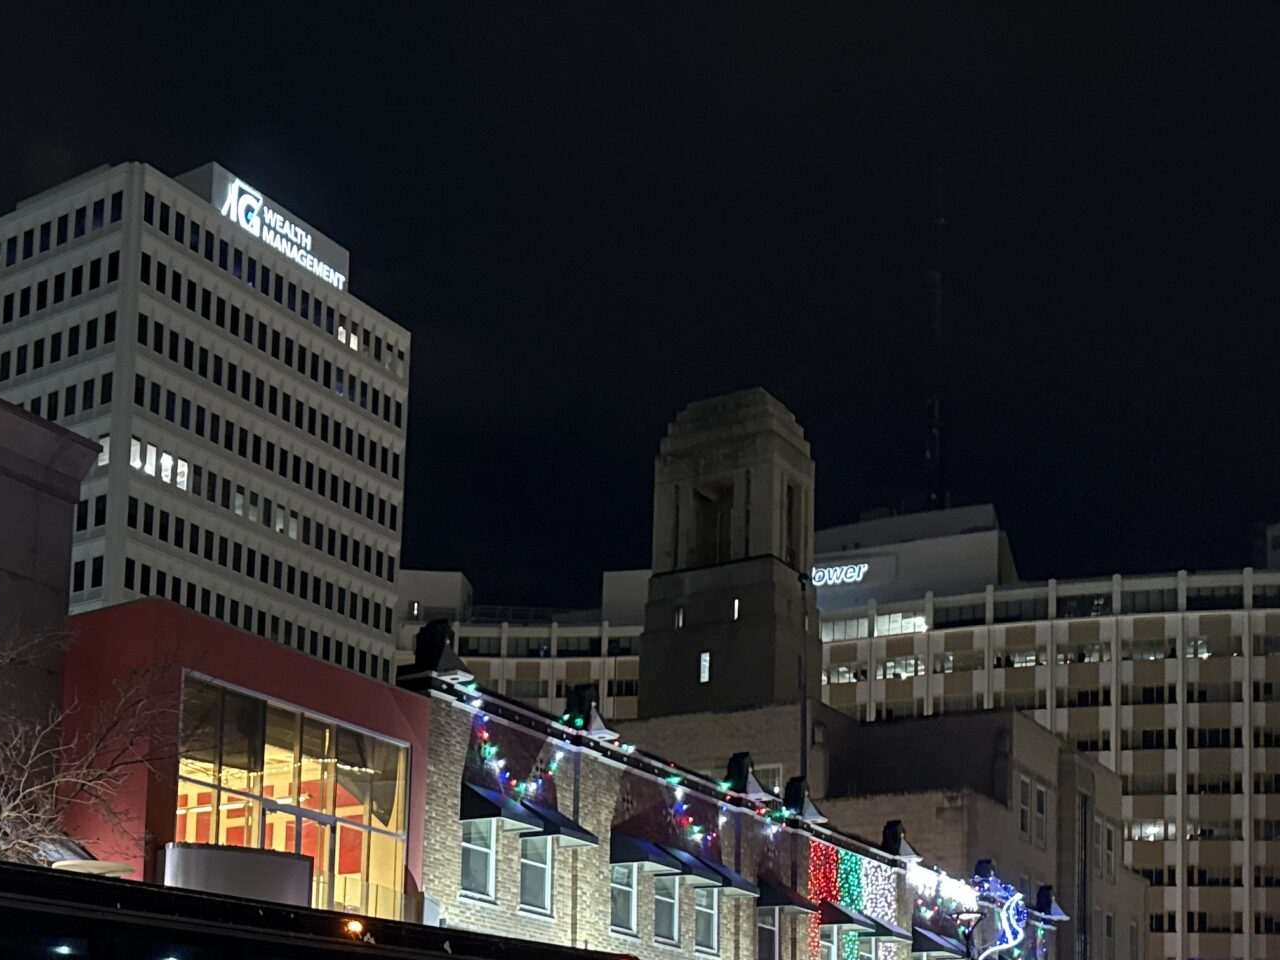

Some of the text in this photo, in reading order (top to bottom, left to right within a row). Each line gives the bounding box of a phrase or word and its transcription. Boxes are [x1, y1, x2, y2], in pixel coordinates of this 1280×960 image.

[263, 206, 312, 251] WEALTH
[262, 226, 346, 290] MANAGEMENT
[812, 563, 869, 586] ower
